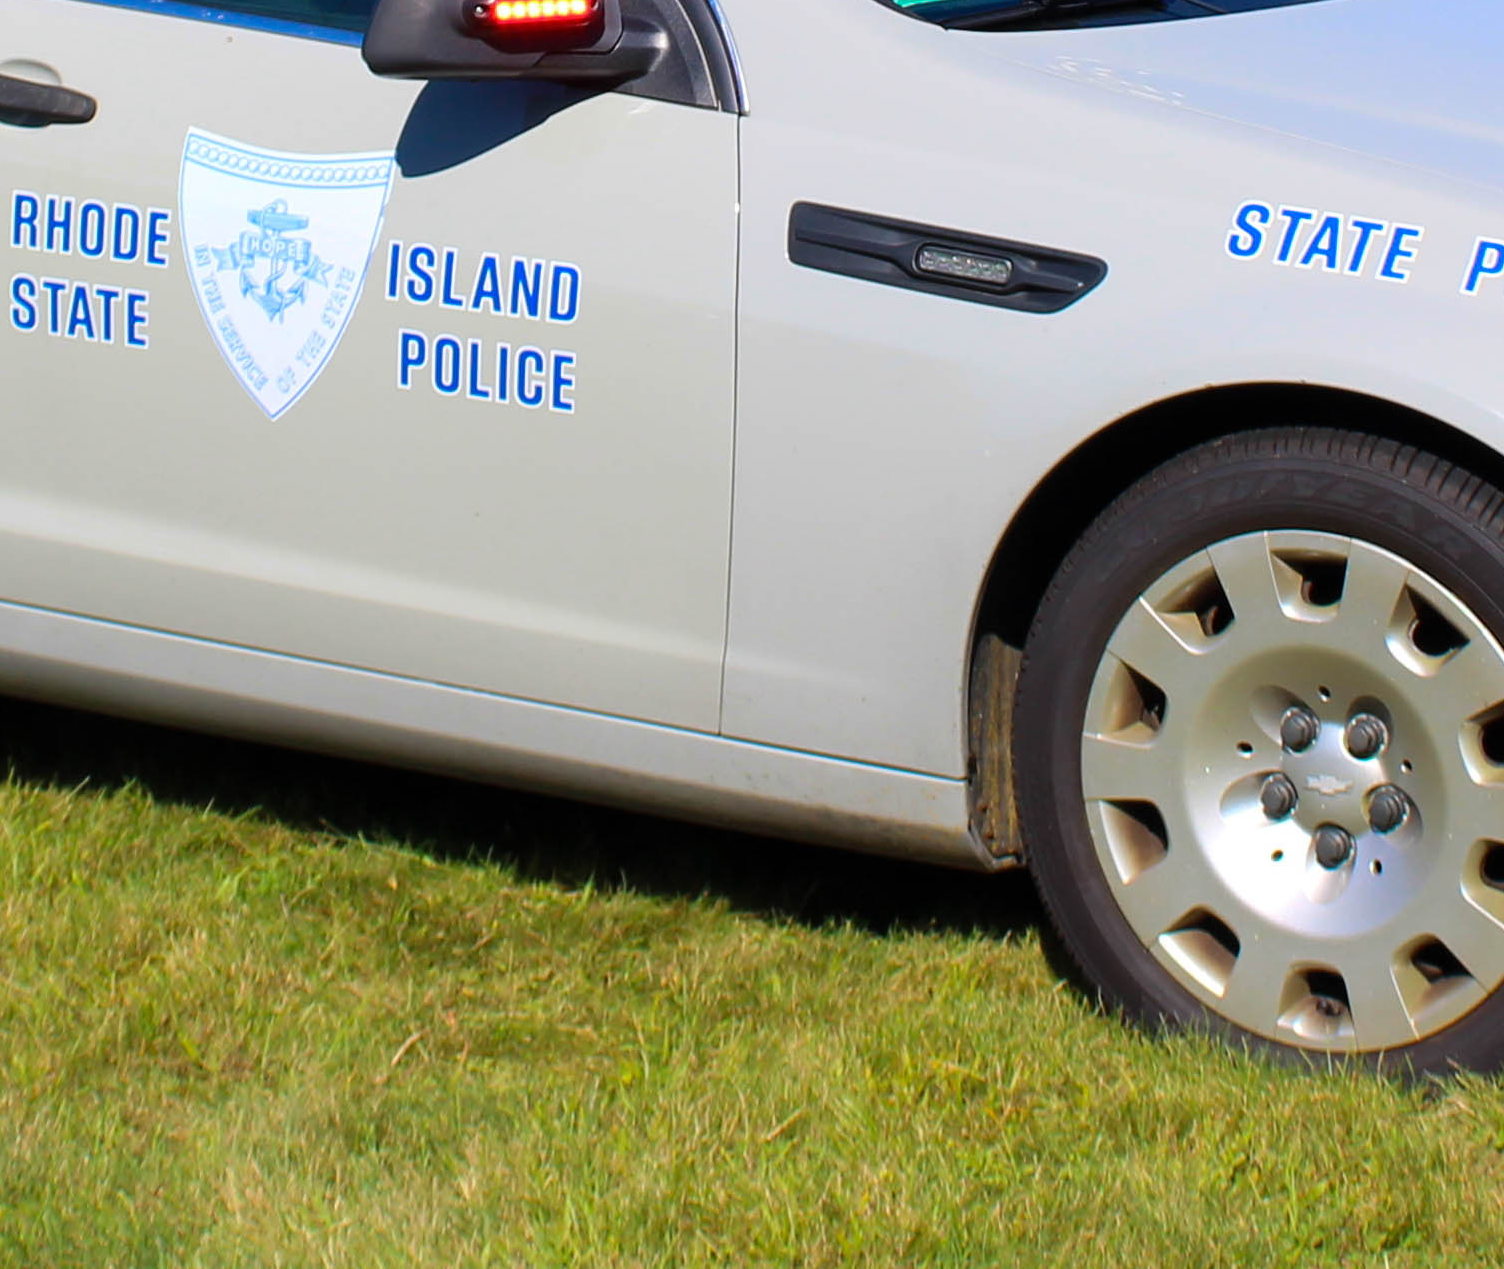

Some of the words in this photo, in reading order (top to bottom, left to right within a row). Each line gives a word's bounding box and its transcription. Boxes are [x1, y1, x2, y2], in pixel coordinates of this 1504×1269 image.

[13, 194, 168, 266] RHODE
[388, 244, 579, 322] ISLAND
[250, 236, 296, 258] HOPE
[1228, 204, 1420, 280] STATE
[12, 277, 146, 347] STATE
[400, 332, 574, 411] POLICE
